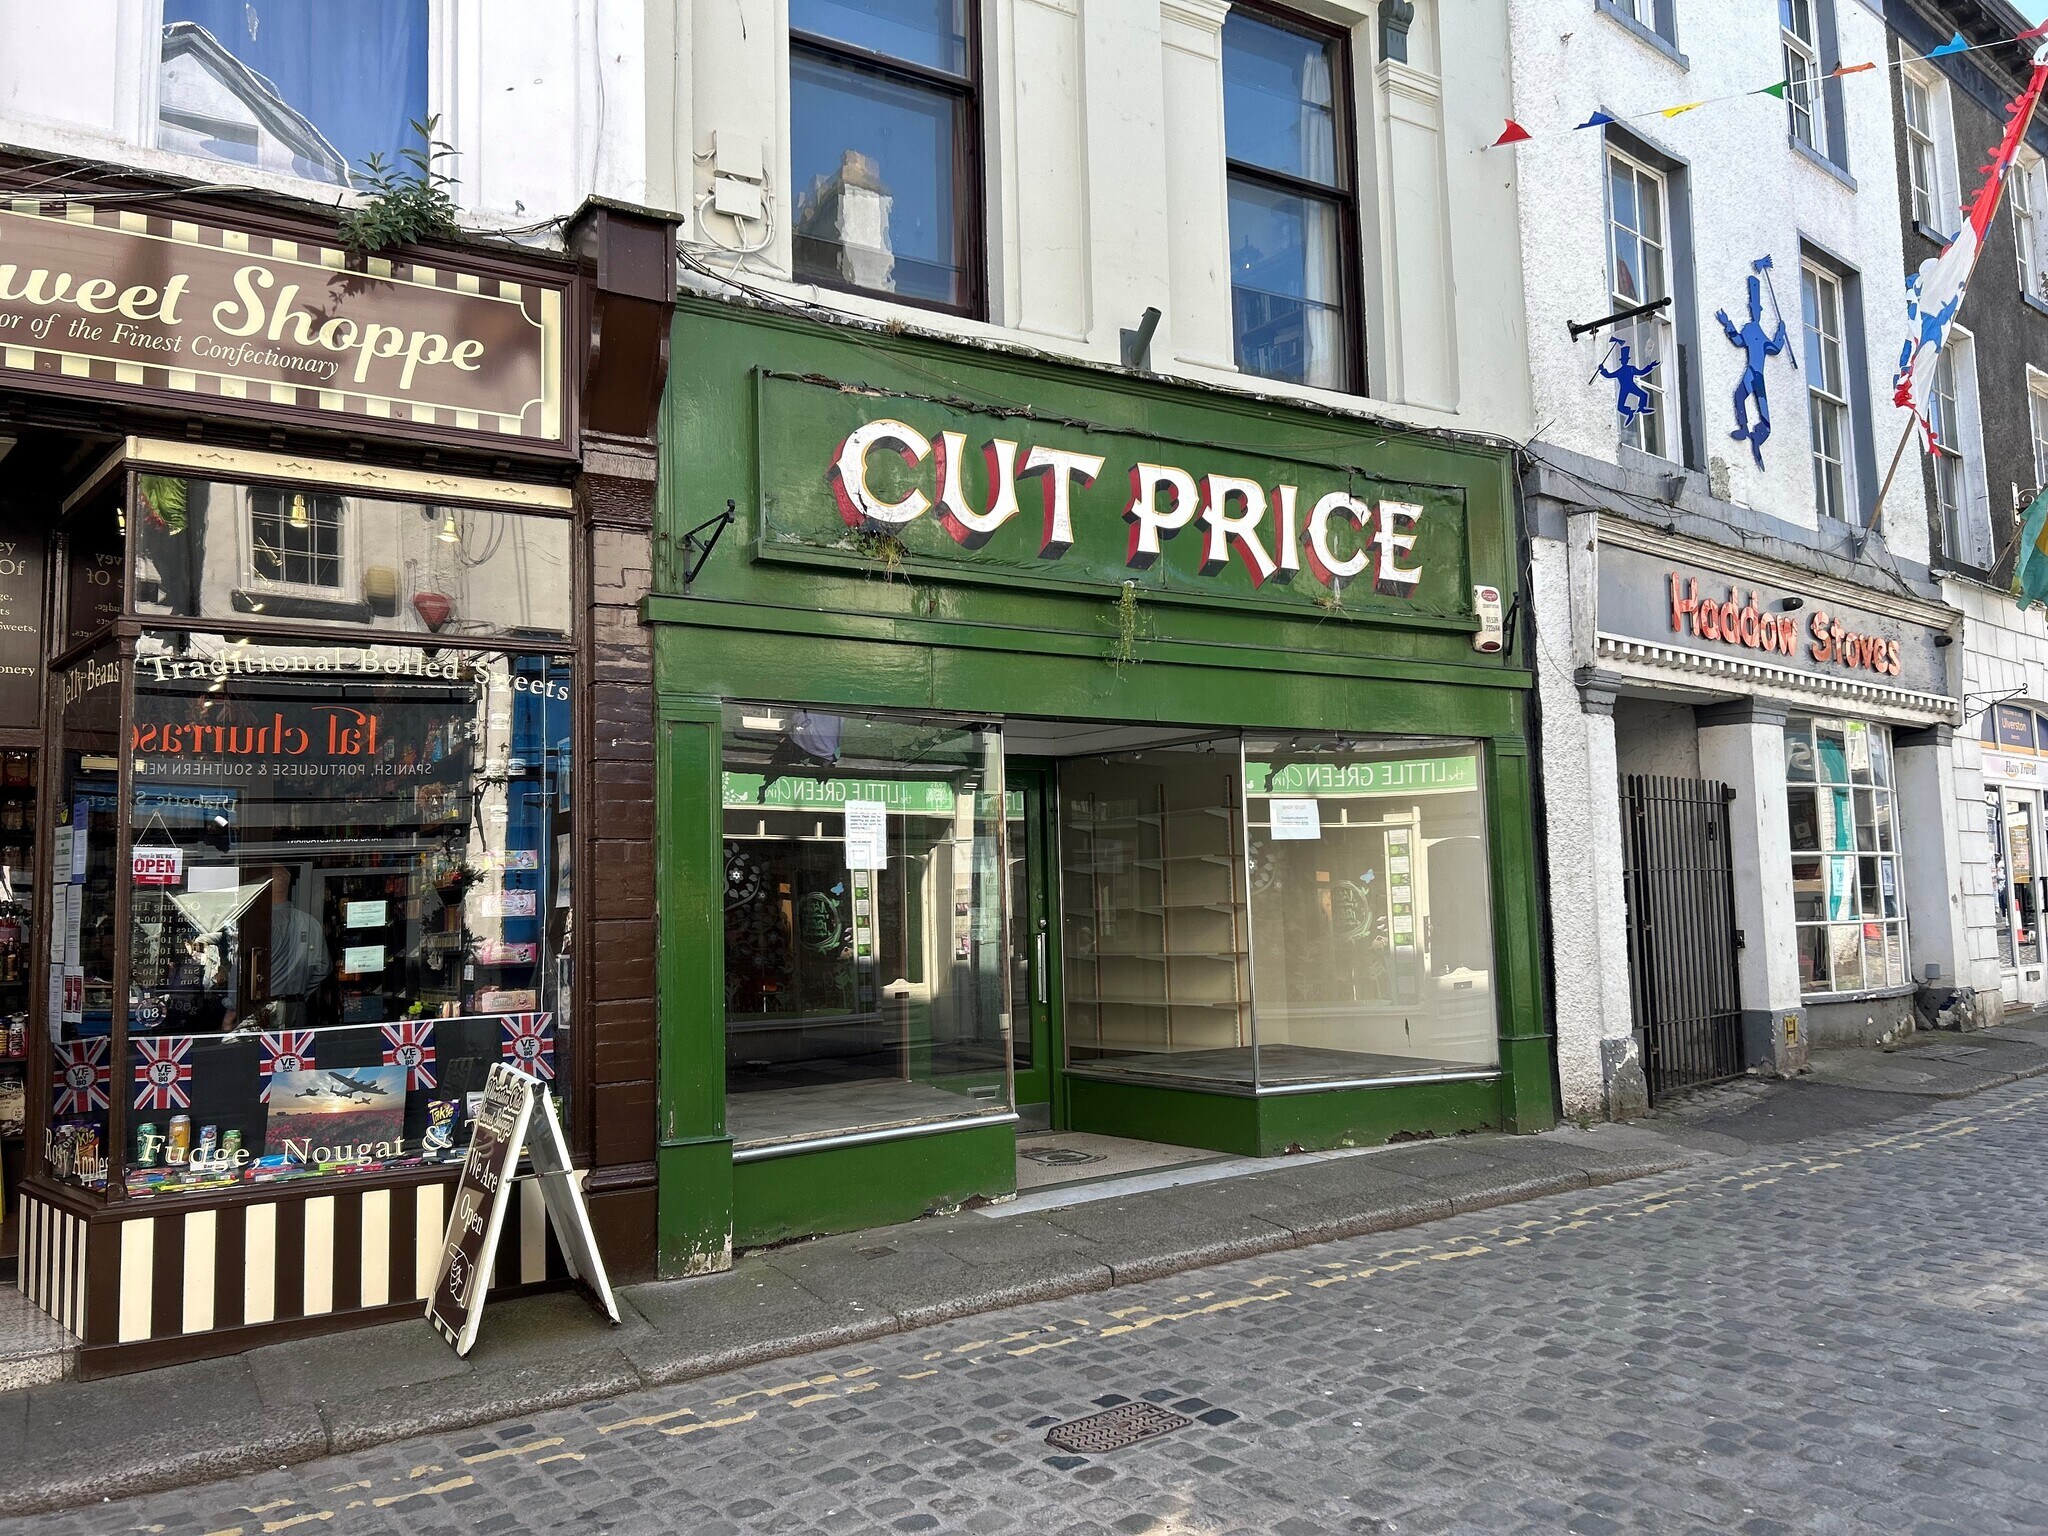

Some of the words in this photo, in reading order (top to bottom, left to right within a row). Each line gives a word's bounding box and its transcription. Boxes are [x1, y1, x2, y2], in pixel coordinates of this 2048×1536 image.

[212, 266, 485, 391] Shoppe
[30, 313, 61, 340] of
[68, 317, 103, 341] the
[109, 322, 183, 353] Finest
[191, 335, 340, 381] Confectionary
[832, 418, 1105, 552] CUT
[1126, 462, 1424, 595] PRICE
[1669, 571, 1798, 657] Haddow
[1810, 610, 1901, 677] Stoves
[144, 649, 343, 683] Traditional
[358, 649, 459, 680] Boiled
[61, 668, 86, 716] Jelly
[87, 658, 120, 692] Beans
[2001, 716, 2027, 732] Ulverston
[134, 858, 176, 873] OPEN
[401, 1048, 416, 1057] VE
[520, 1039, 535, 1047] VE
[72, 1067, 89, 1077] VE
[156, 1064, 172, 1074] VE
[280, 1058, 296, 1067] VE
[429, 1106, 455, 1125] Takis
[138, 1133, 260, 1172] Fudge,
[281, 1136, 406, 1167] Nougat
[421, 1125, 453, 1151] &
[468, 1147, 482, 1183] We
[480, 1160, 498, 1194] Are
[460, 1193, 484, 1236] Open
